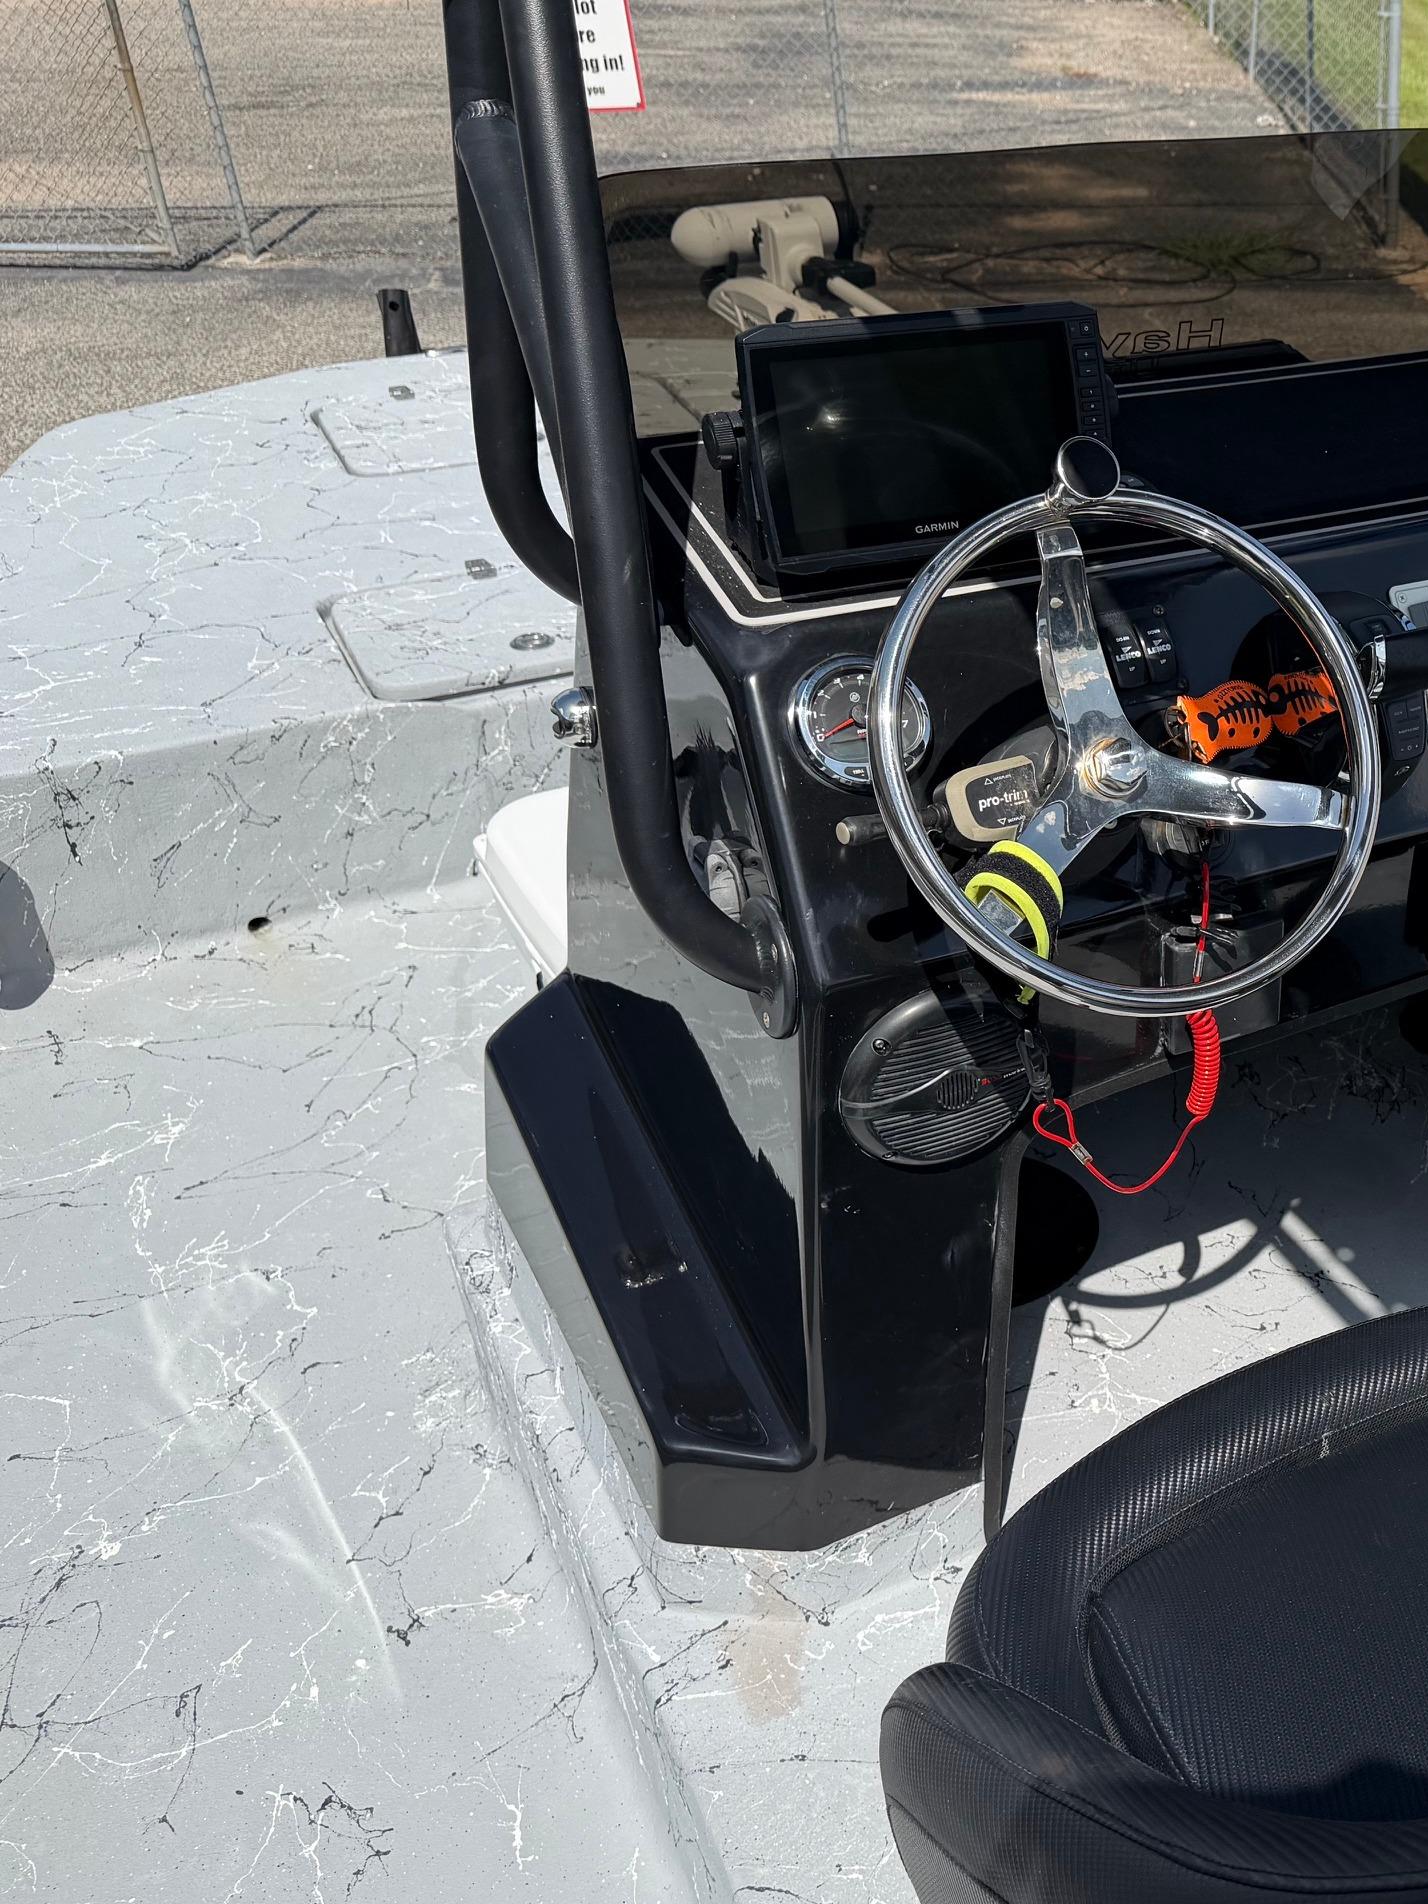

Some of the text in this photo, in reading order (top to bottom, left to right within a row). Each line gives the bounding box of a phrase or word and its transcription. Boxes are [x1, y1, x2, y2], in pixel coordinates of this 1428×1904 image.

[602, 54, 624, 71] in!
[587, 86, 606, 96] you
[915, 520, 959, 534] GARMIN
[1147, 643, 1171, 655] LENCO
[1115, 650, 1141, 662] LENCO
[901, 719, 909, 728] 7
[978, 789, 1029, 812] pro-trim
